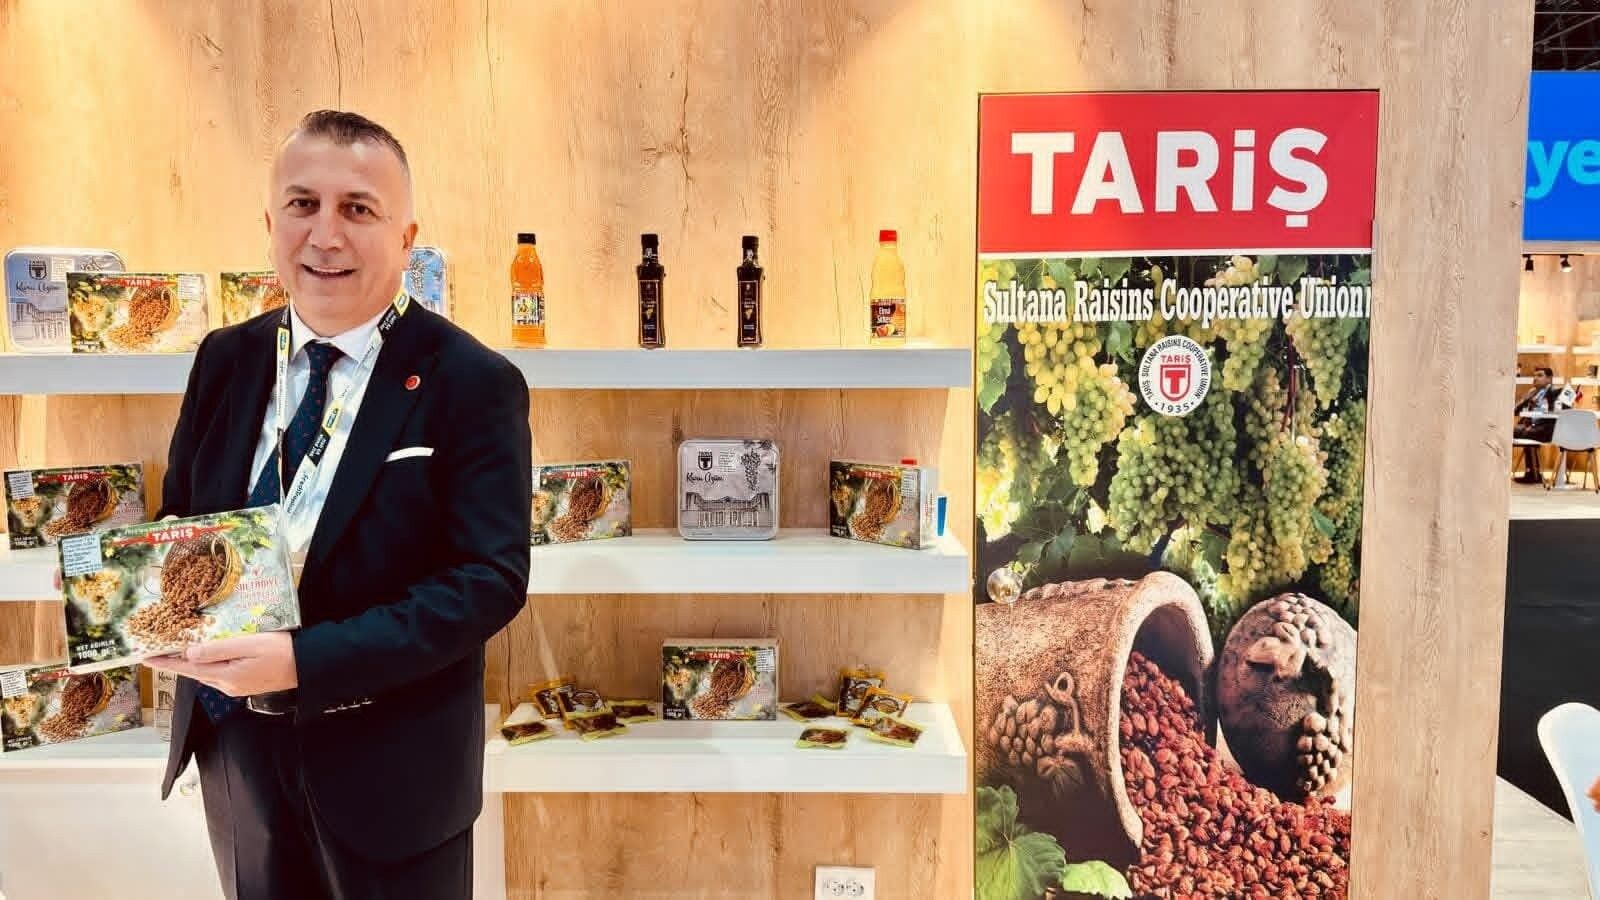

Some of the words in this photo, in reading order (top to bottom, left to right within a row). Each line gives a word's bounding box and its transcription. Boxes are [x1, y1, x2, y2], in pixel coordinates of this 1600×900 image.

[983, 279, 1067, 323] Sultana
[1073, 277, 1154, 322] Raisins
[1160, 275, 1294, 329] Cooperative
[1165, 370, 1187, 394] T
